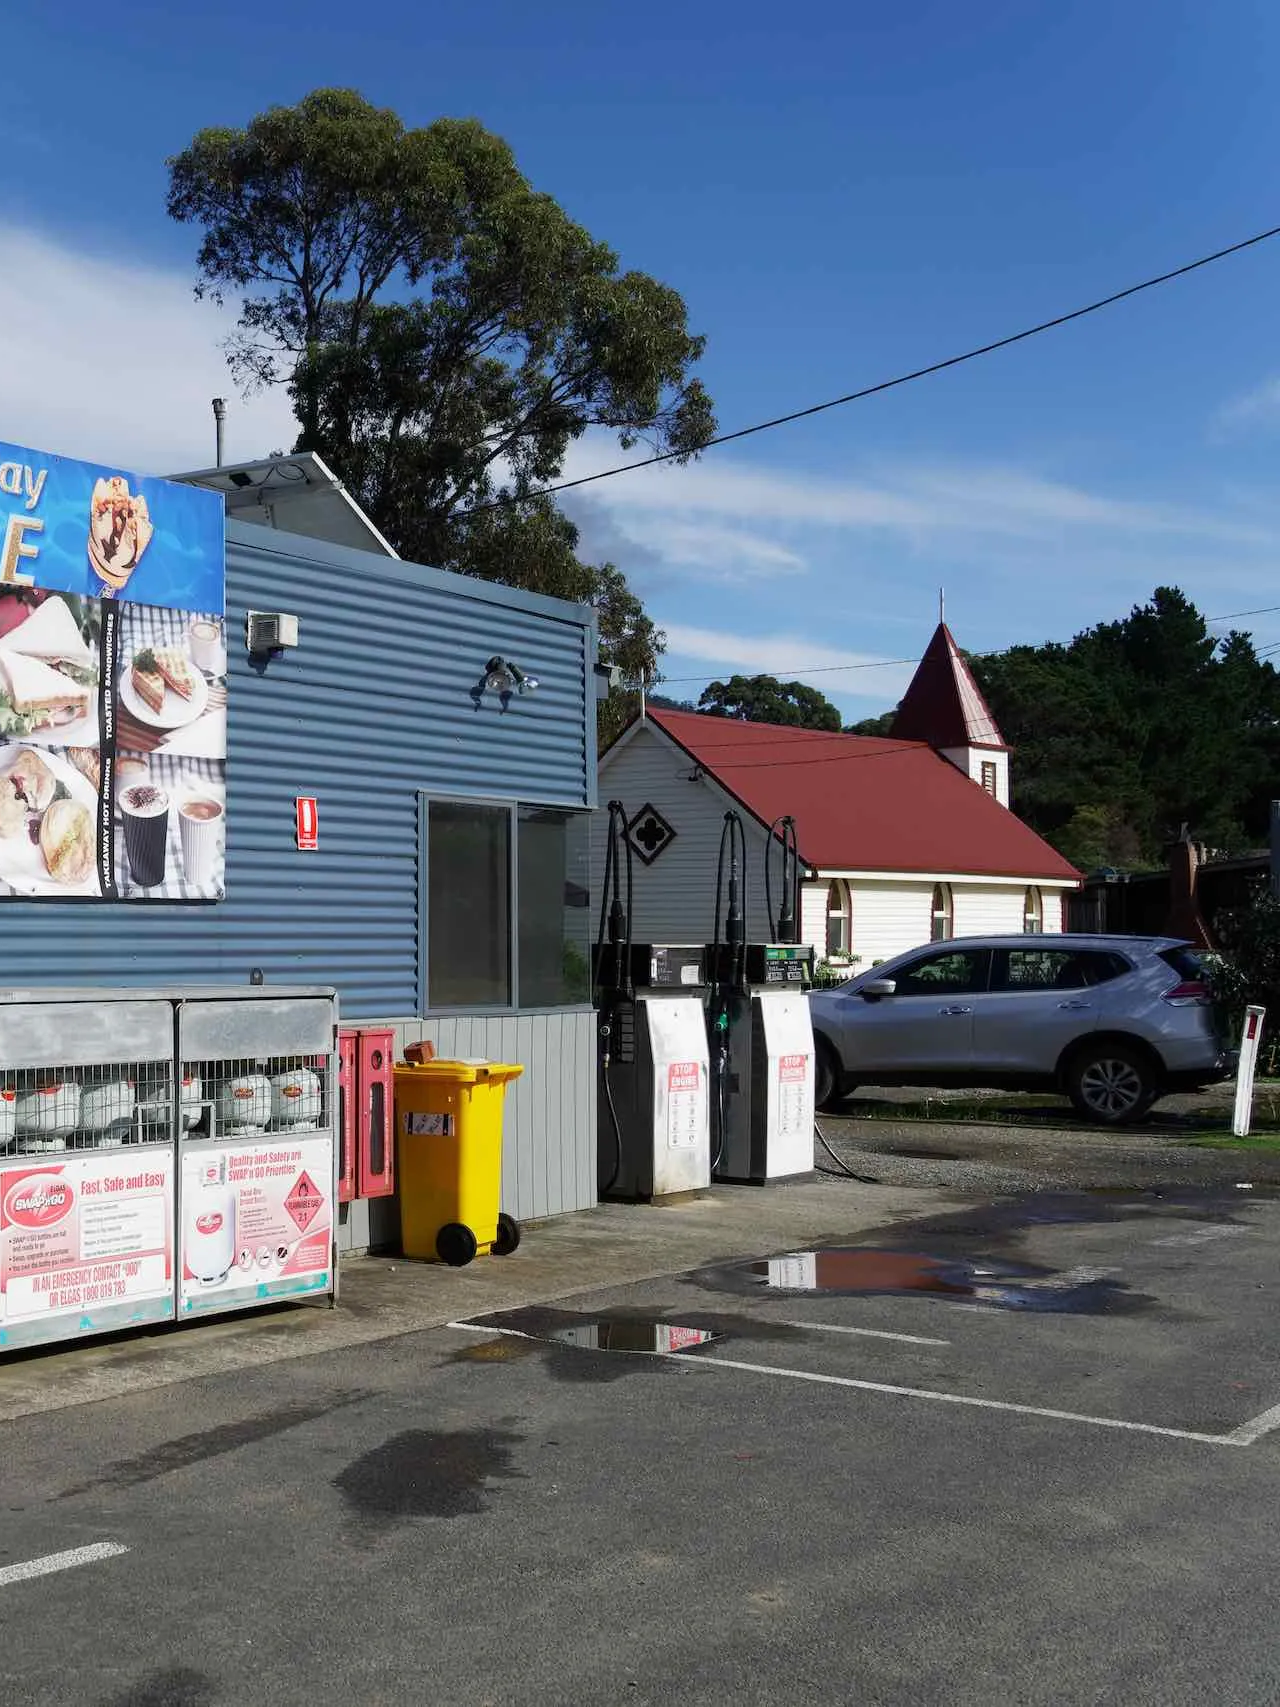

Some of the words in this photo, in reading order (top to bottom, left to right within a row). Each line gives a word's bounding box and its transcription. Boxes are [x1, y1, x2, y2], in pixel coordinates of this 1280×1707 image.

[105, 613, 115, 687] SANDWICHES
[104, 689, 113, 740] TOASTED
[103, 758, 112, 800] DRINKS
[102, 802, 110, 826] HOT
[102, 828, 111, 889] TAKEAWAY
[104, 1176, 124, 1192] Safe
[126, 1173, 143, 1189] and
[145, 1173, 165, 1187] Easy
[52, 1267, 92, 1291] EMERGENCY
[93, 1263, 121, 1283] CONTACT
